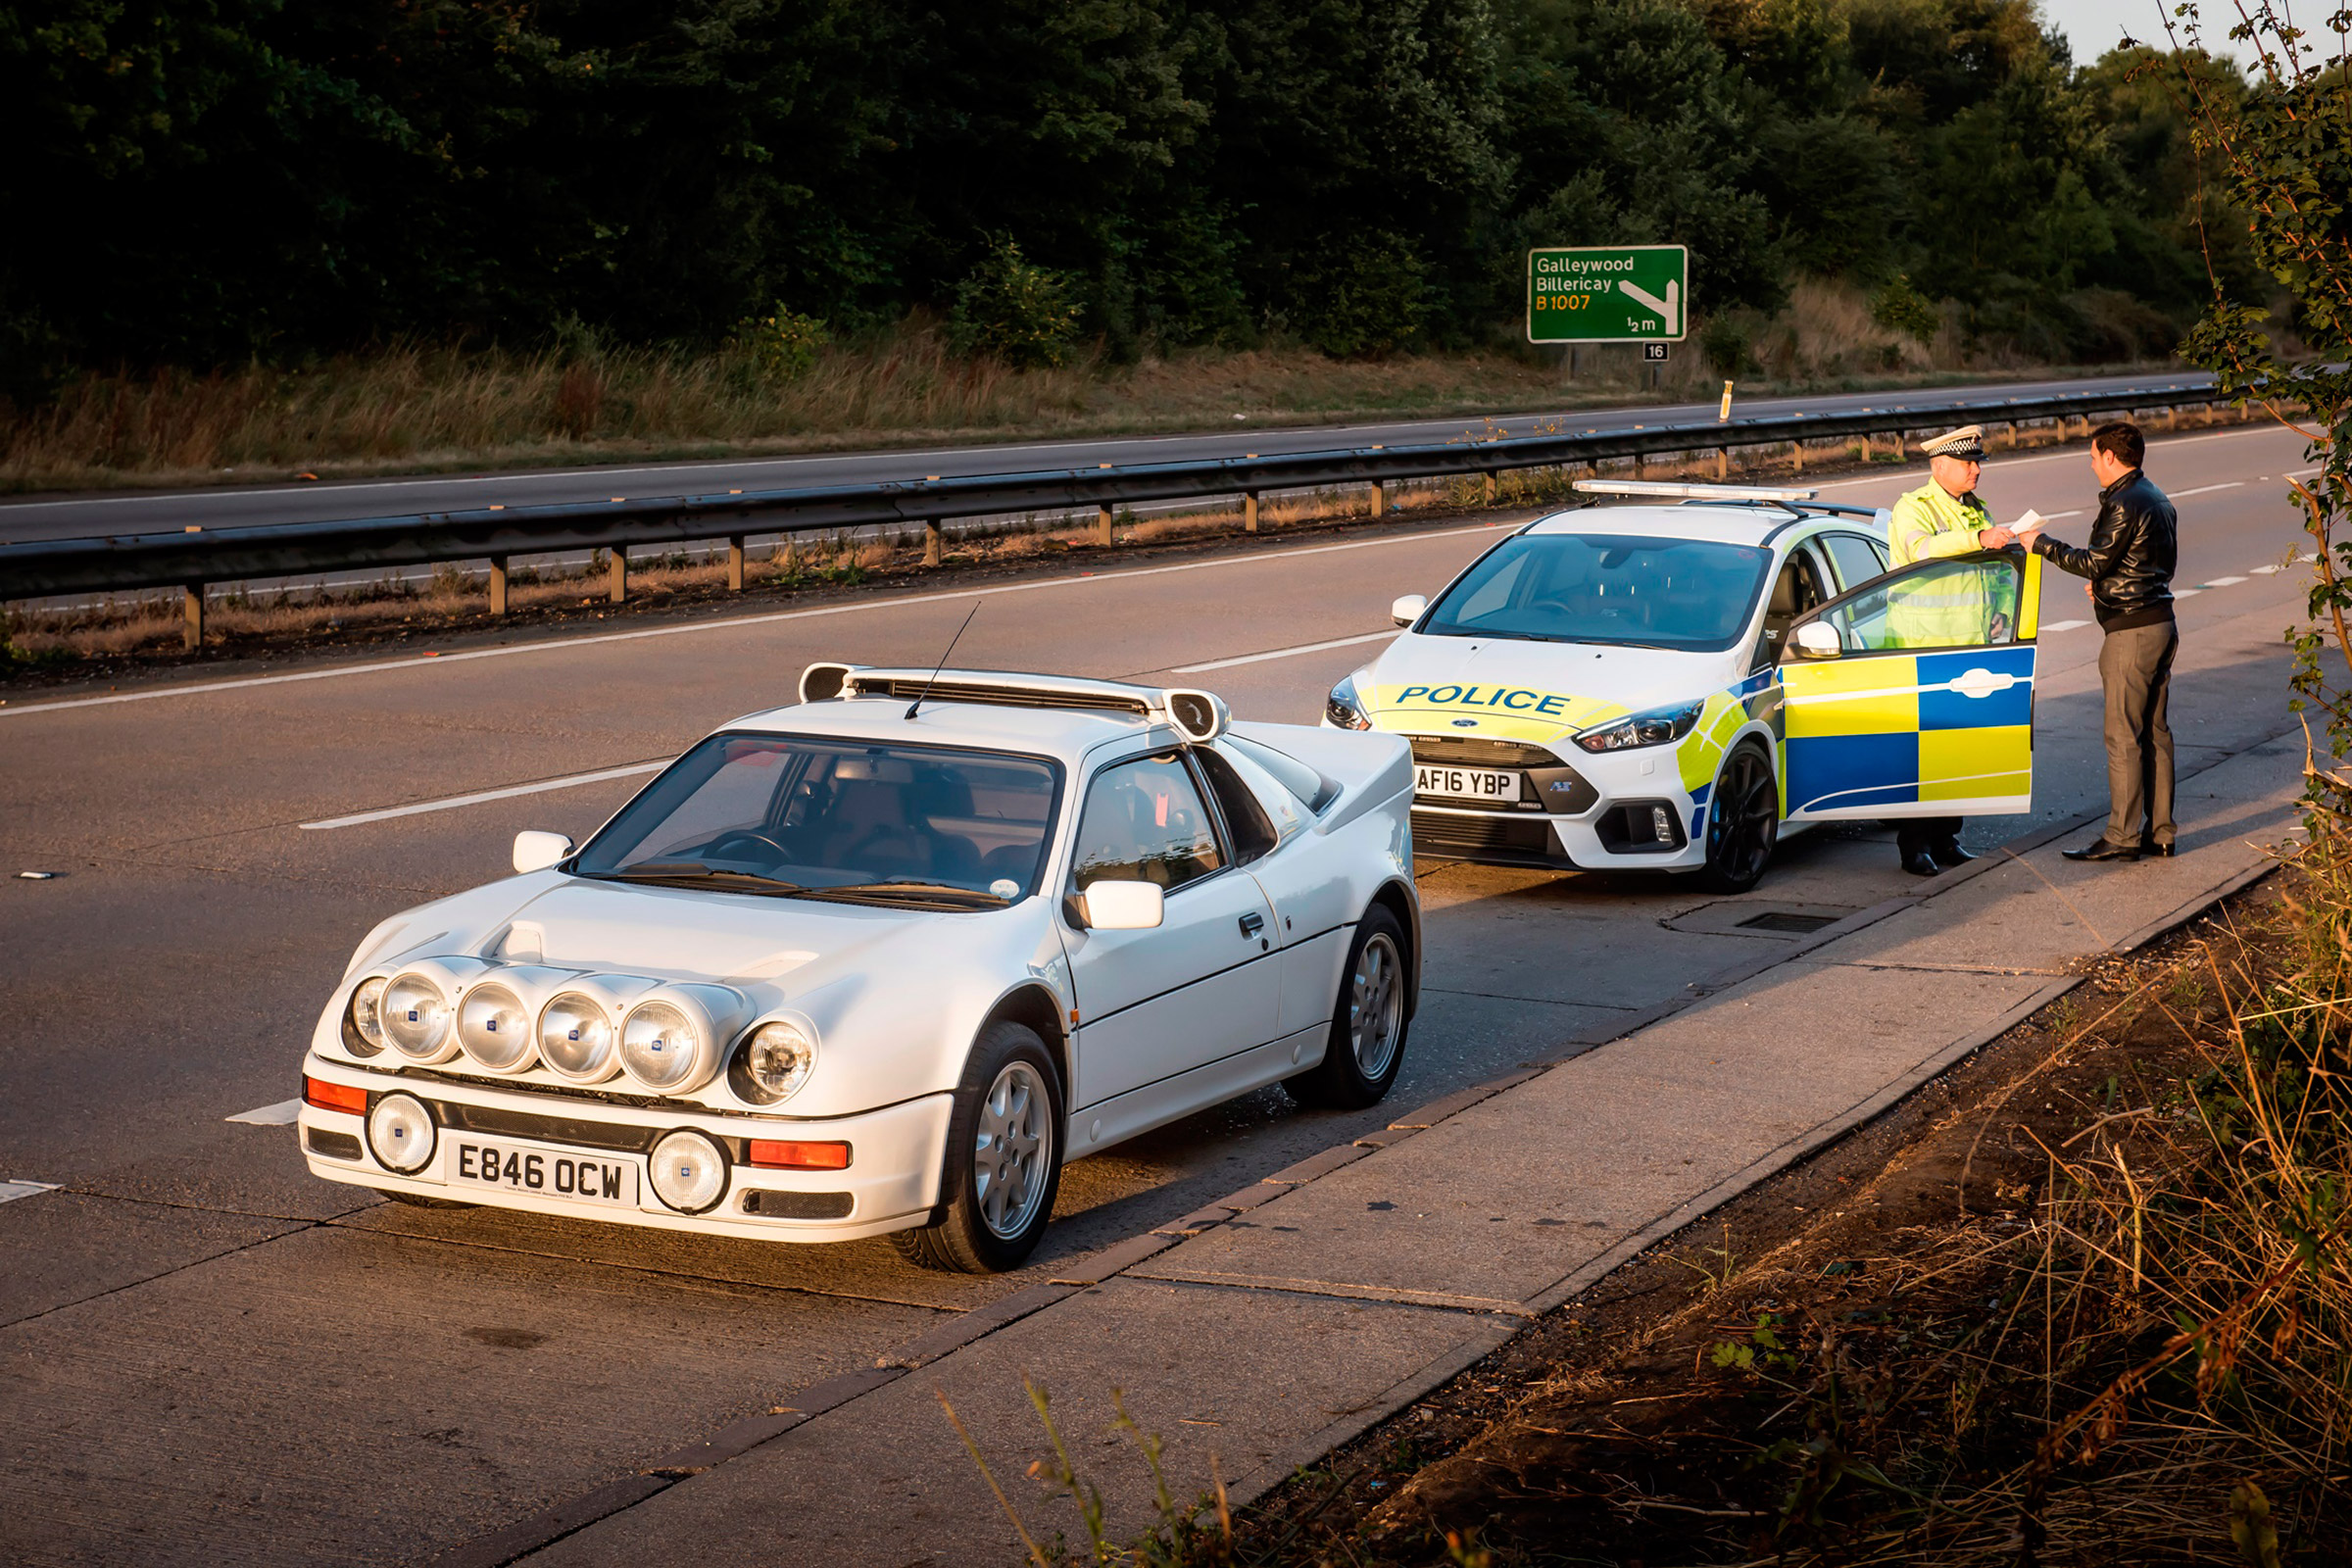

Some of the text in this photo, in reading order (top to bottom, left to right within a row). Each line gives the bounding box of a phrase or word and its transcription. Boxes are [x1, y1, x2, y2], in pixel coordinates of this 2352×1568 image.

[1537, 256, 1634, 274] Galleywood
[1536, 277, 1612, 293] Billericay
[1536, 295, 1591, 311] B 1007
[1648, 346, 1663, 358] 16
[1396, 685, 1571, 715] POLICE
[1417, 769, 1510, 795] AF16 YBP
[460, 1144, 621, 1200] E846 OCW
